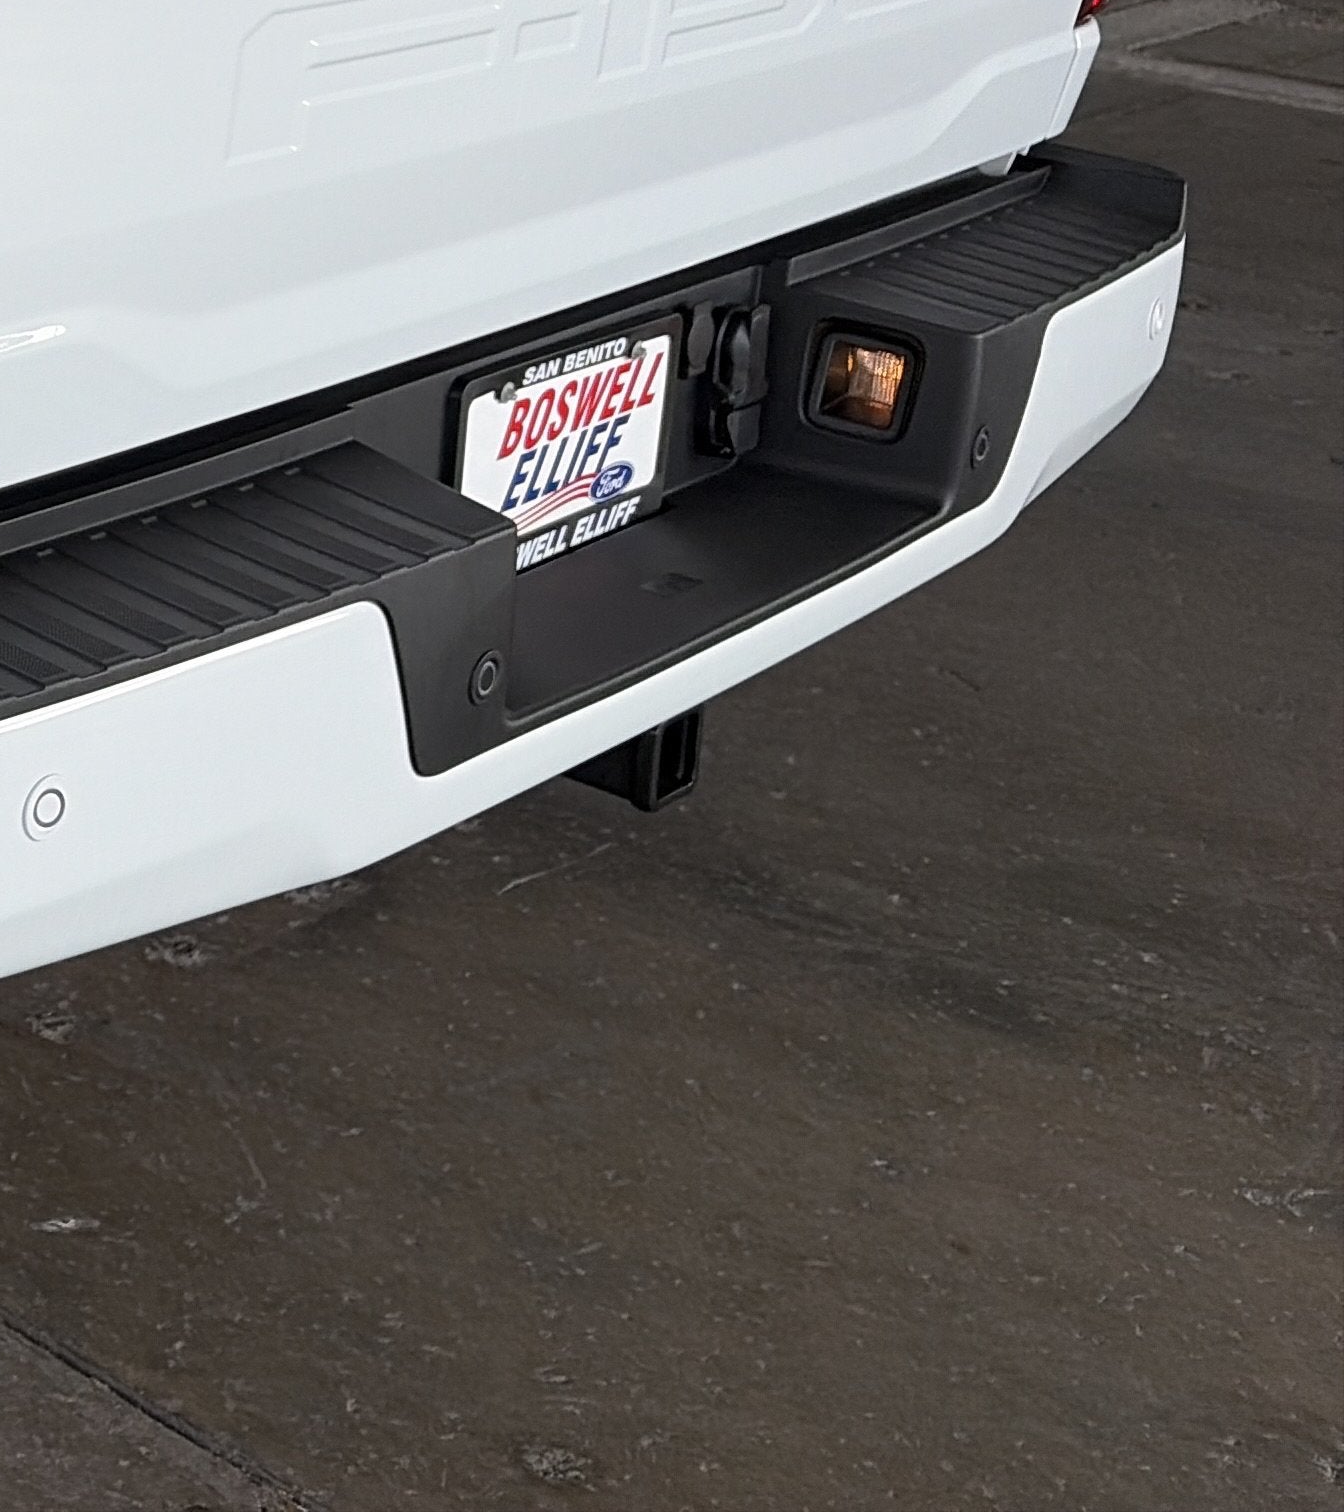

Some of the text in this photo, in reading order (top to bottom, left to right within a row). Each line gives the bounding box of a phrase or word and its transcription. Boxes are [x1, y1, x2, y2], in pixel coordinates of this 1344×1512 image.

[522, 336, 628, 386] SAN BENITO
[496, 351, 665, 461] BOSWELL
[500, 413, 632, 513] ELLIFF
[515, 494, 643, 572] WELL ELLIFF
